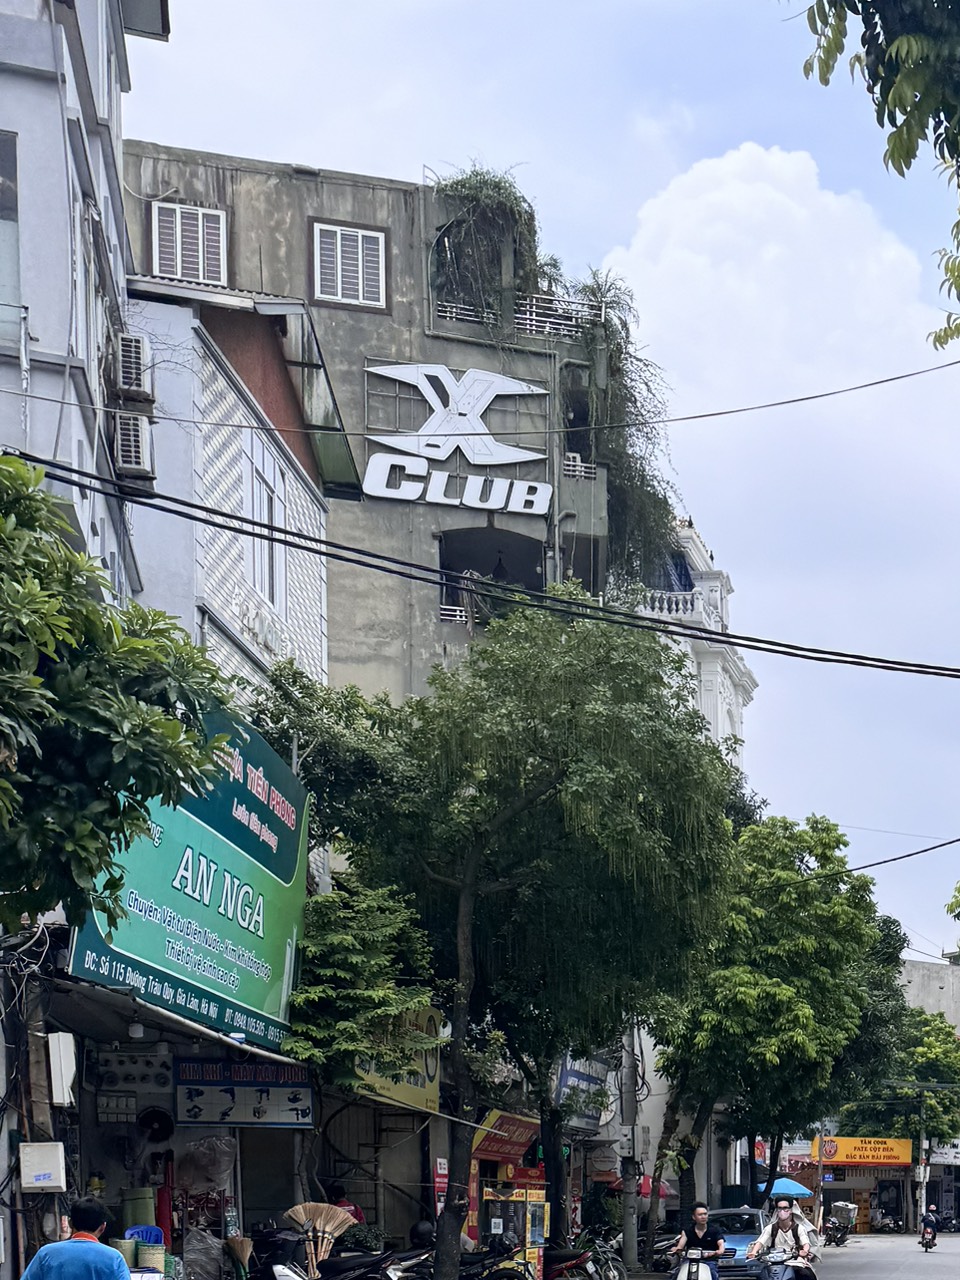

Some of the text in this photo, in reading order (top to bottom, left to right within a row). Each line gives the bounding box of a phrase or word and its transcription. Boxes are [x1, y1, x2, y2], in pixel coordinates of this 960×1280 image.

[362, 364, 550, 465] X
[361, 452, 553, 515] CLUB
[269, 785, 297, 831] PHONG
[127, 889, 161, 923] Chuyên:
[162, 906, 176, 932] Vật
[185, 919, 203, 944] Điện
[171, 845, 265, 939] AN NGA
[165, 937, 185, 964] Thiết
[85, 950, 98, 971] ĐC:
[99, 955, 110, 975] Số
[112, 961, 125, 981] 115
[126, 967, 147, 993] Đường
[177, 988, 187, 1007] Gia
[187, 992, 200, 1014] Lâm,
[201, 997, 208, 1015] Hà
[208, 1001, 219, 1021] Nội
[179, 1063, 201, 1080] KIM
[203, 1062, 224, 1081] KHÍ
[231, 1062, 254, 1081] MÁY
